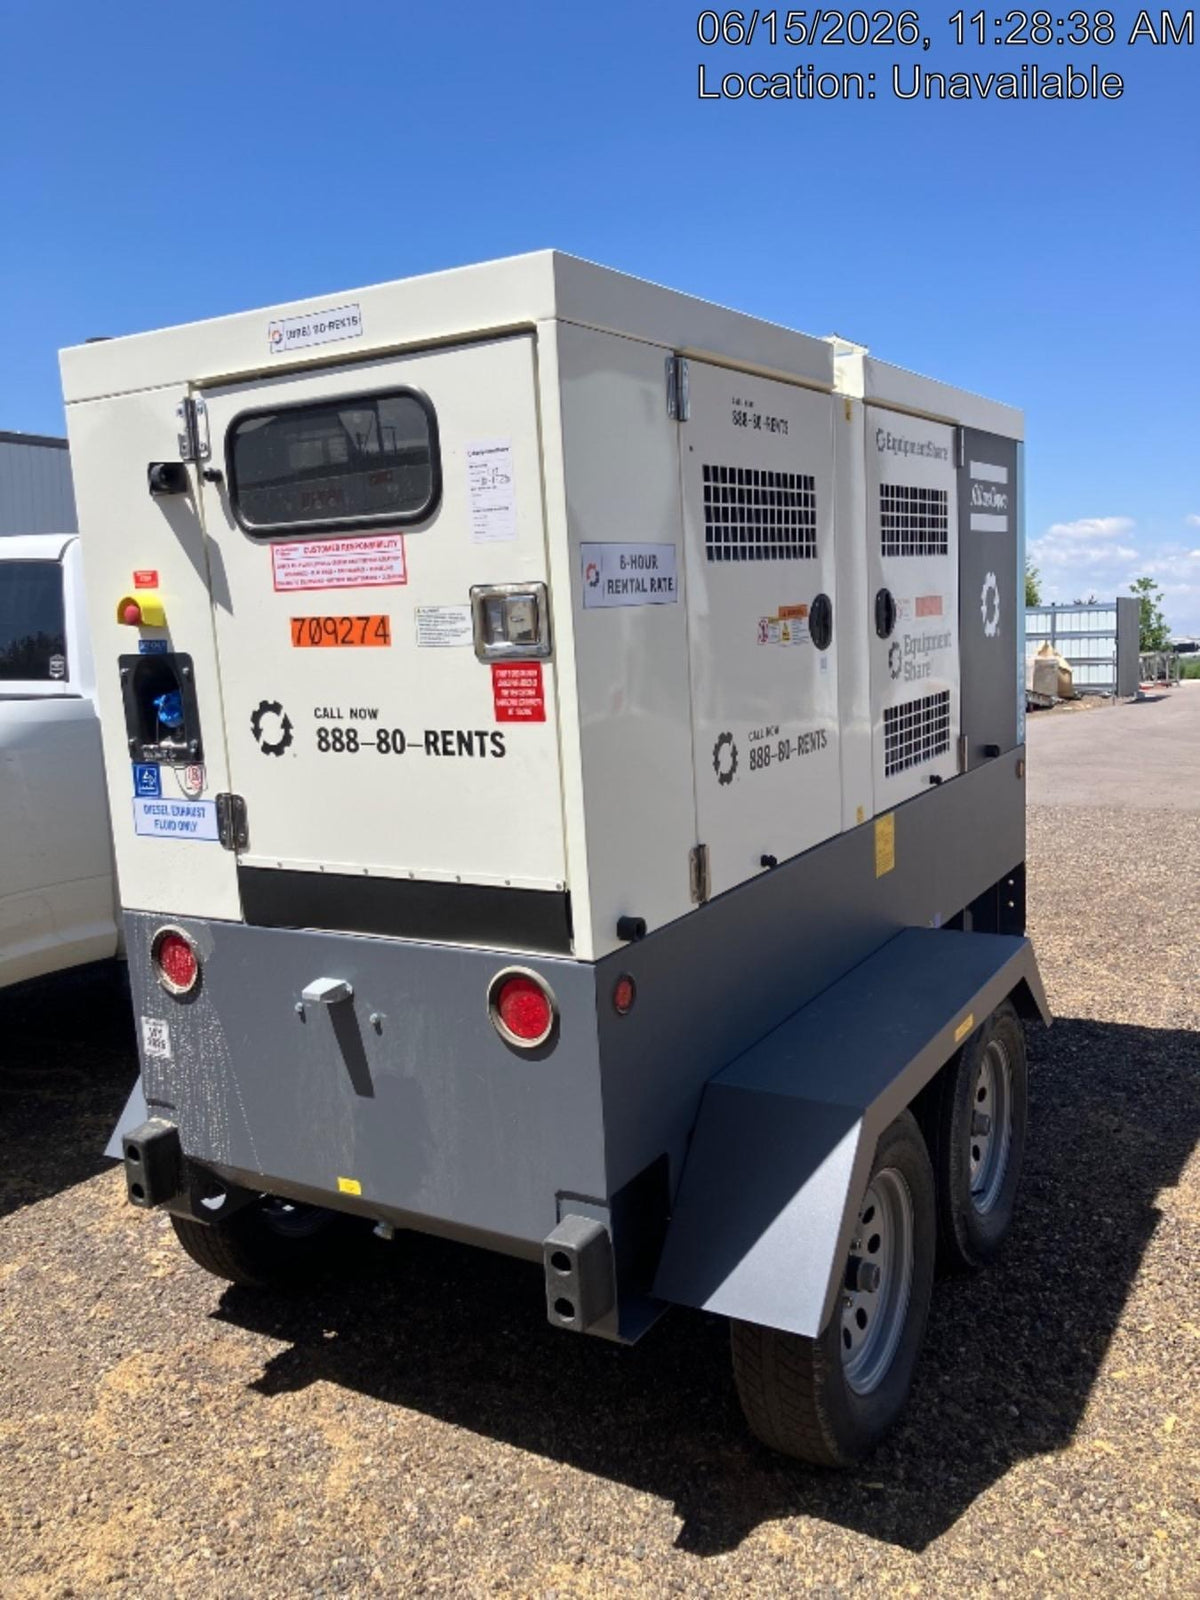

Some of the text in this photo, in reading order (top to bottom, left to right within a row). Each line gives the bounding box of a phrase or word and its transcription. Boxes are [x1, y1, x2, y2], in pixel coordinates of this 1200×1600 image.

[607, 577, 674, 594] RENTAL RATE
[293, 616, 390, 645] 709274
[314, 707, 379, 720] CALL NOW
[748, 729, 764, 742] CALL
